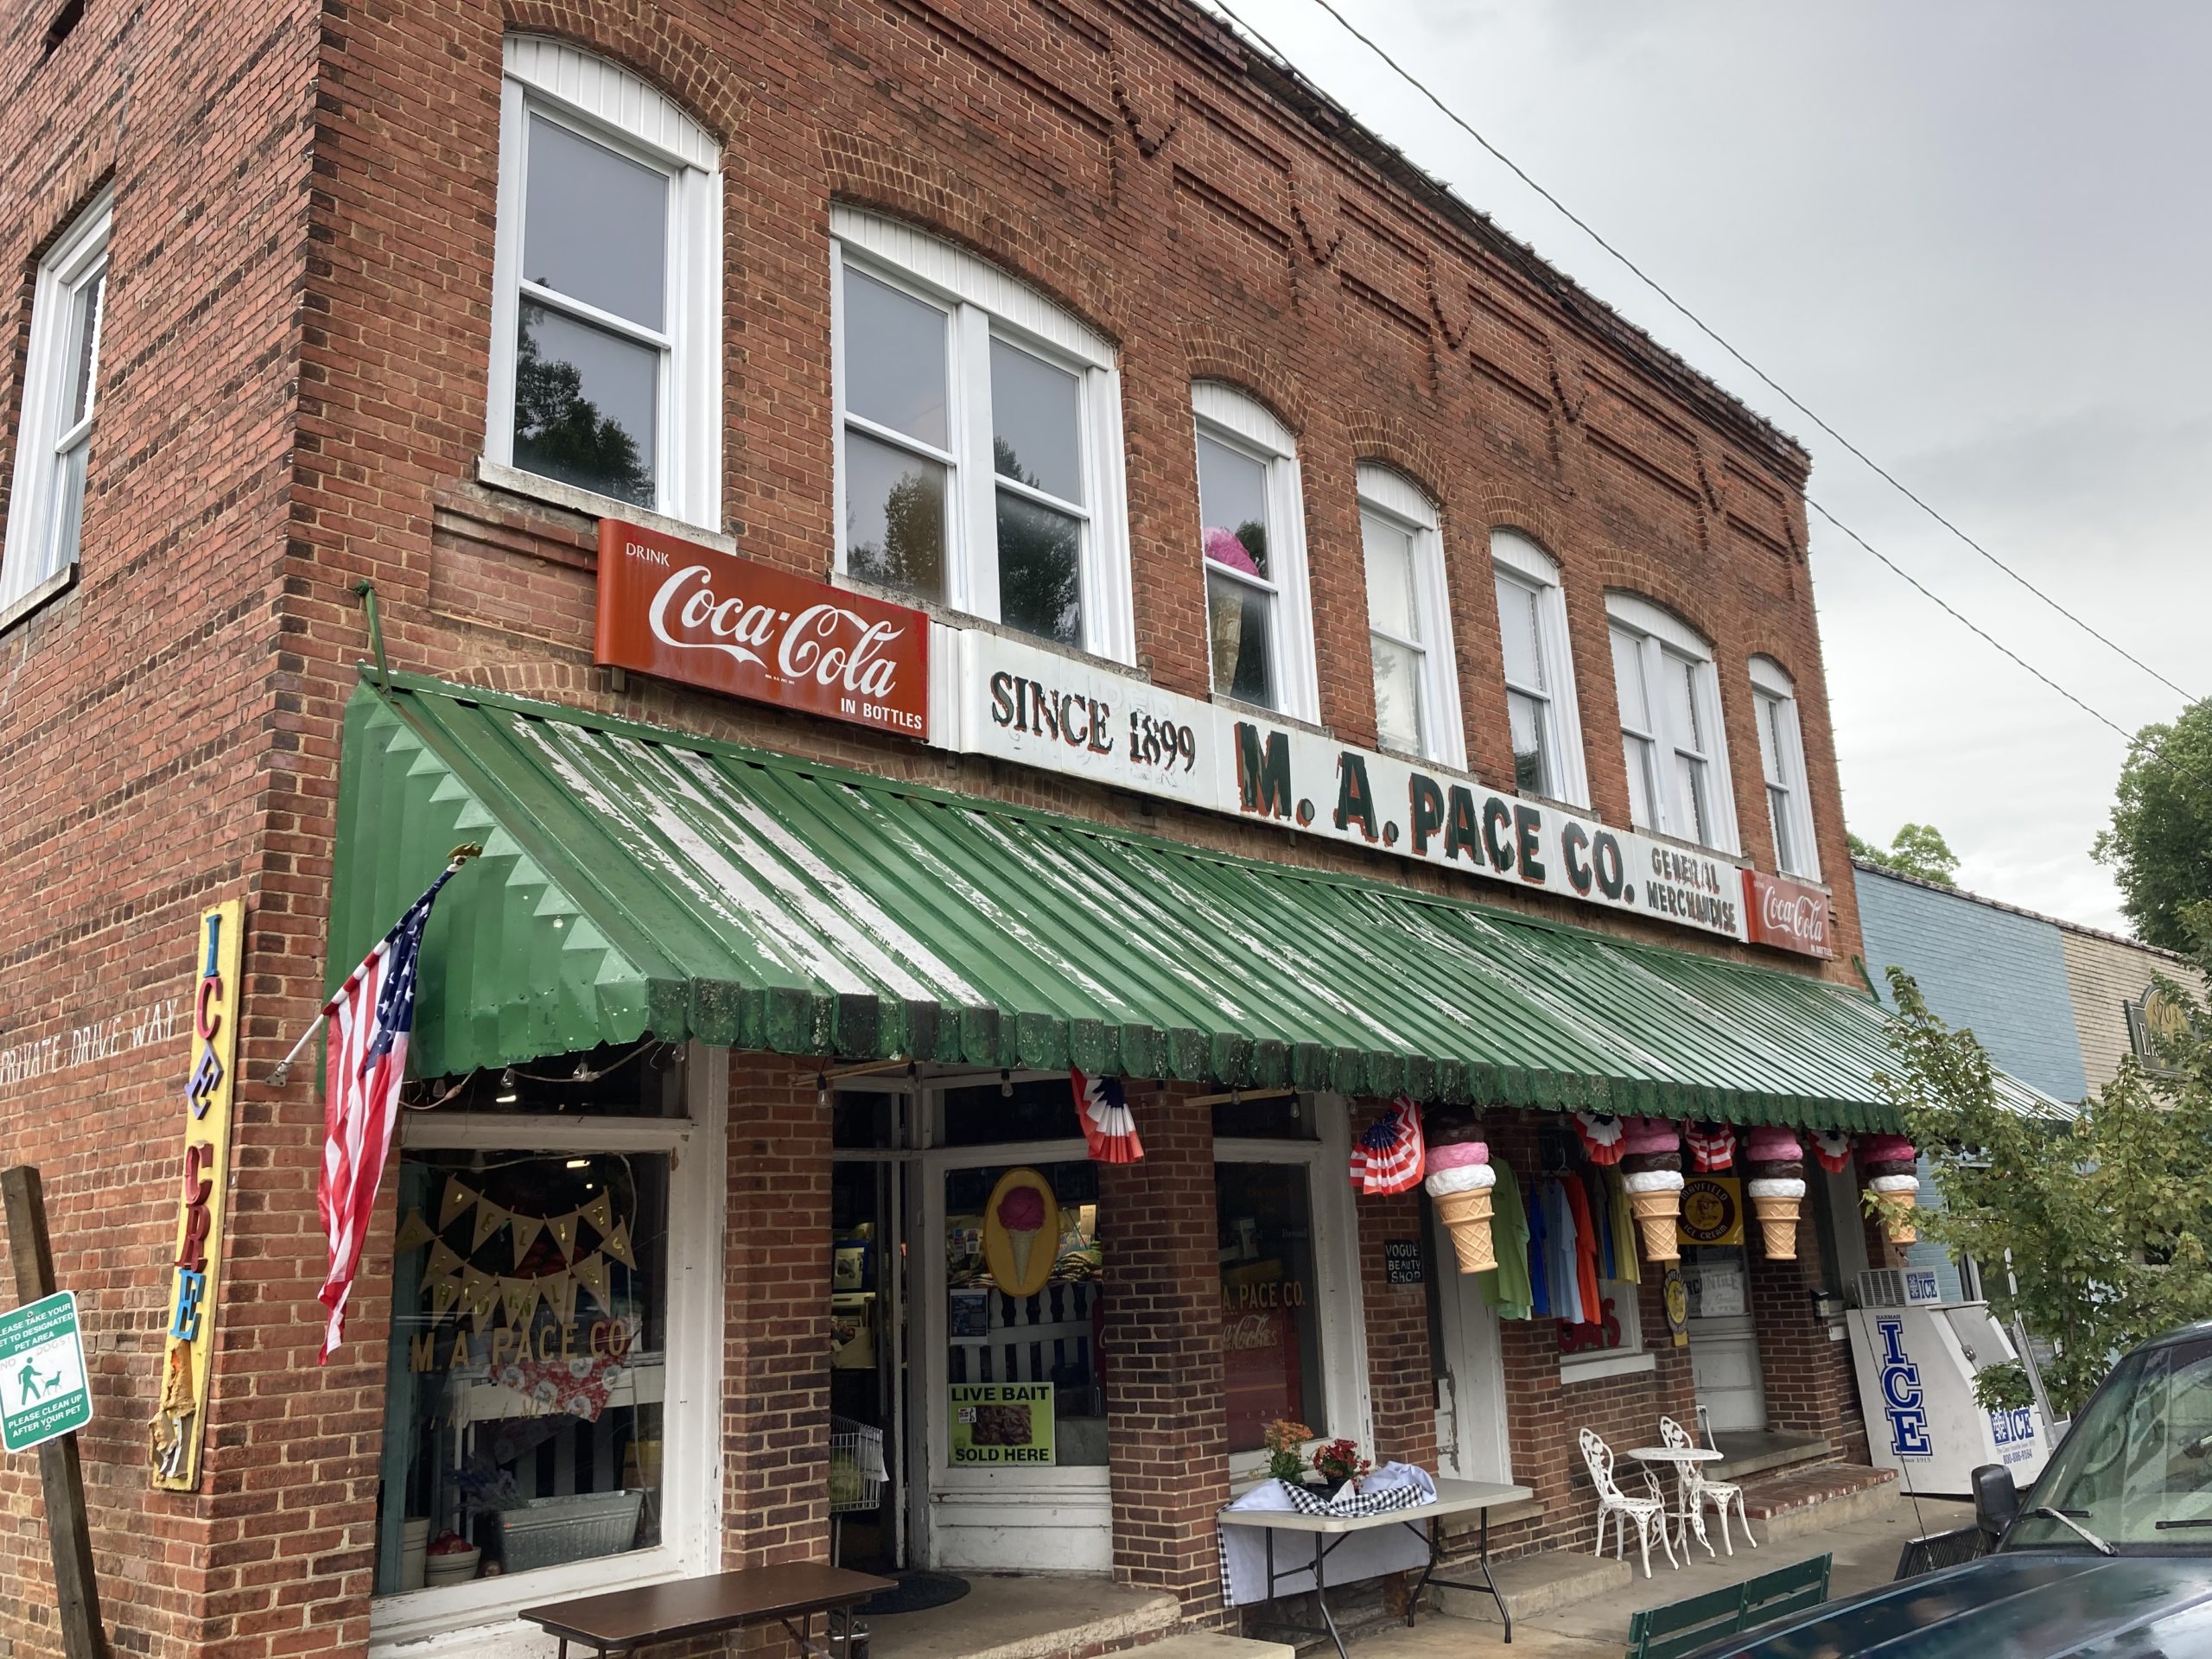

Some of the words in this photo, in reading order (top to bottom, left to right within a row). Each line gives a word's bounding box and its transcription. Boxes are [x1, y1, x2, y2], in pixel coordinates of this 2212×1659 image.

[626, 542, 671, 568] DRINK
[649, 565, 906, 698] Coca-Cola
[841, 697, 855, 715] IN
[863, 701, 922, 730] BOTTLES
[991, 671, 1114, 754] SINCE
[1129, 710, 1196, 774] 1899
[1233, 721, 1315, 828] M.
[1333, 750, 1400, 848] A.
[1408, 772, 1546, 886] PACE
[1561, 821, 1636, 905] CO.
[1651, 847, 1720, 895] GENERAL
[1646, 880, 1737, 934] MERCHANDISE
[1763, 886, 1823, 942] Coca-Cola
[184, 913, 225, 1120] ICE
[0, 1035, 61, 1085] PRIVATE
[70, 1015, 122, 1069] DRIVE
[132, 999, 178, 1048] WAY
[1681, 1182, 1728, 1200] MAYFIELD
[1684, 1224, 1697, 1236] ICE
[1700, 1224, 1728, 1239] CREAM
[1385, 1243, 1418, 1257] VOGUE
[1389, 1259, 1421, 1270] BEAUTY
[1391, 1271, 1421, 1283] SHOP
[1918, 1279, 1938, 1299] ICE
[1239, 1281, 1278, 1309] PACE
[1283, 1281, 1306, 1306] CO.
[0, 1320, 24, 1337] EASE
[25, 1312, 47, 1325] TAKE
[48, 1302, 71, 1317] YOUR
[10, 1333, 21, 1343] TO
[22, 1313, 73, 1338] DESIGNATED
[14, 1339, 31, 1352] PET
[32, 1331, 54, 1346] AREA
[492, 1320, 580, 1367] PACE
[590, 1318, 626, 1358] CO
[951, 1387, 996, 1402] LIVE
[1002, 1386, 1050, 1401] BAIT
[1877, 1319, 1933, 1457] ICE
[8, 1410, 41, 1429] PLEASE
[41, 1398, 70, 1416] CLEAN
[70, 1394, 83, 1404] UP
[12, 1421, 40, 1439] AFTER
[41, 1411, 65, 1427] YOUR
[65, 1404, 81, 1417] PET
[2006, 1408, 2035, 1442] ICE
[955, 1448, 1000, 1462] SOLD
[1004, 1448, 1049, 1461] HERE
